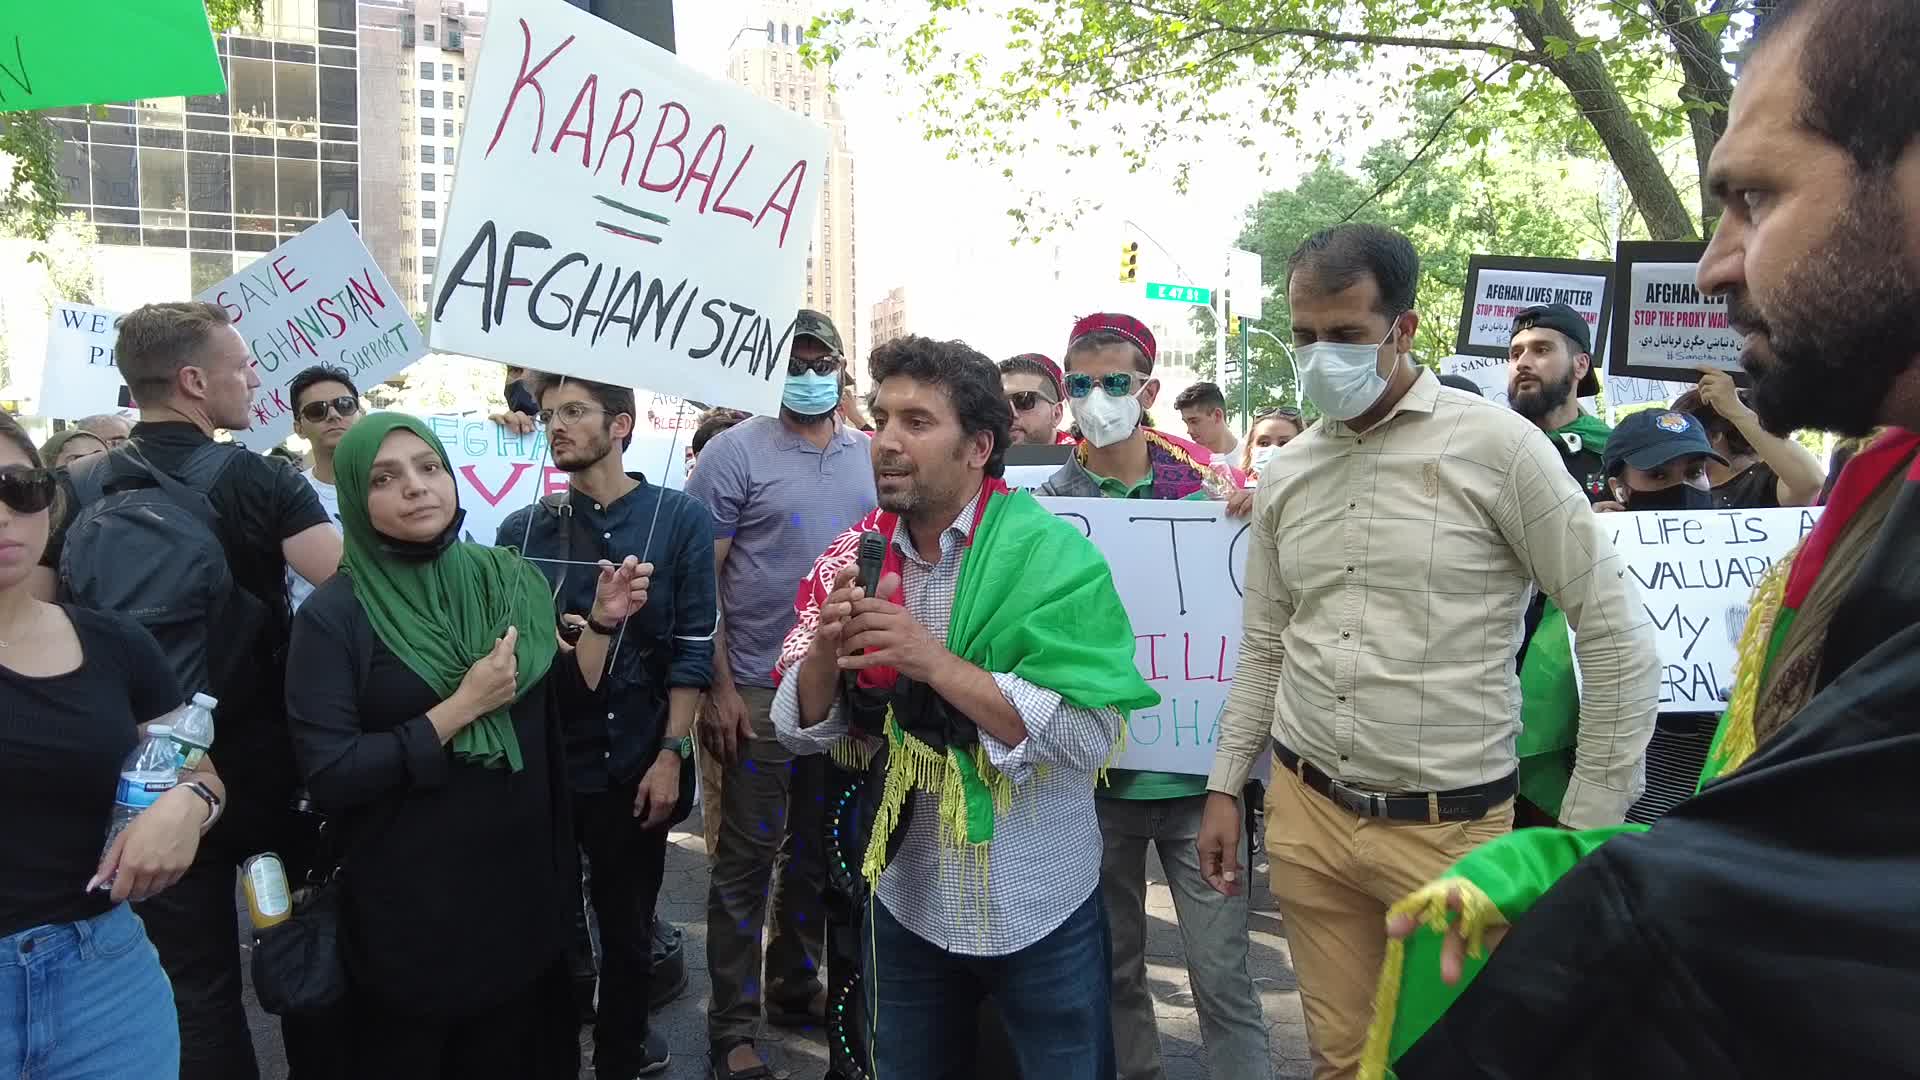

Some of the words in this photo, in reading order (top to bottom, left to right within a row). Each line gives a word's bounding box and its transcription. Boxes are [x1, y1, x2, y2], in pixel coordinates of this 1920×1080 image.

[485, 17, 807, 249] KARBALA
[217, 255, 308, 324] SAVE
[434, 219, 798, 381] AFGHANISTAN
[1158, 285, 1167, 298] E
[1168, 287, 1184, 300] 47
[1486, 283, 1524, 302] AFGHAN
[1525, 286, 1553, 303] LIVES
[1553, 288, 1593, 306] MATTER
[1645, 282, 1700, 305] AFGHAN
[61, 308, 107, 334] WE
[250, 267, 386, 373] GHANISTAN
[1476, 303, 1491, 316] STOP
[1493, 305, 1504, 317] THE
[1634, 309, 1657, 326] STOP
[1659, 311, 1675, 327] THE
[1676, 312, 1707, 329] PROXY
[1718, 512, 1769, 545] IS
